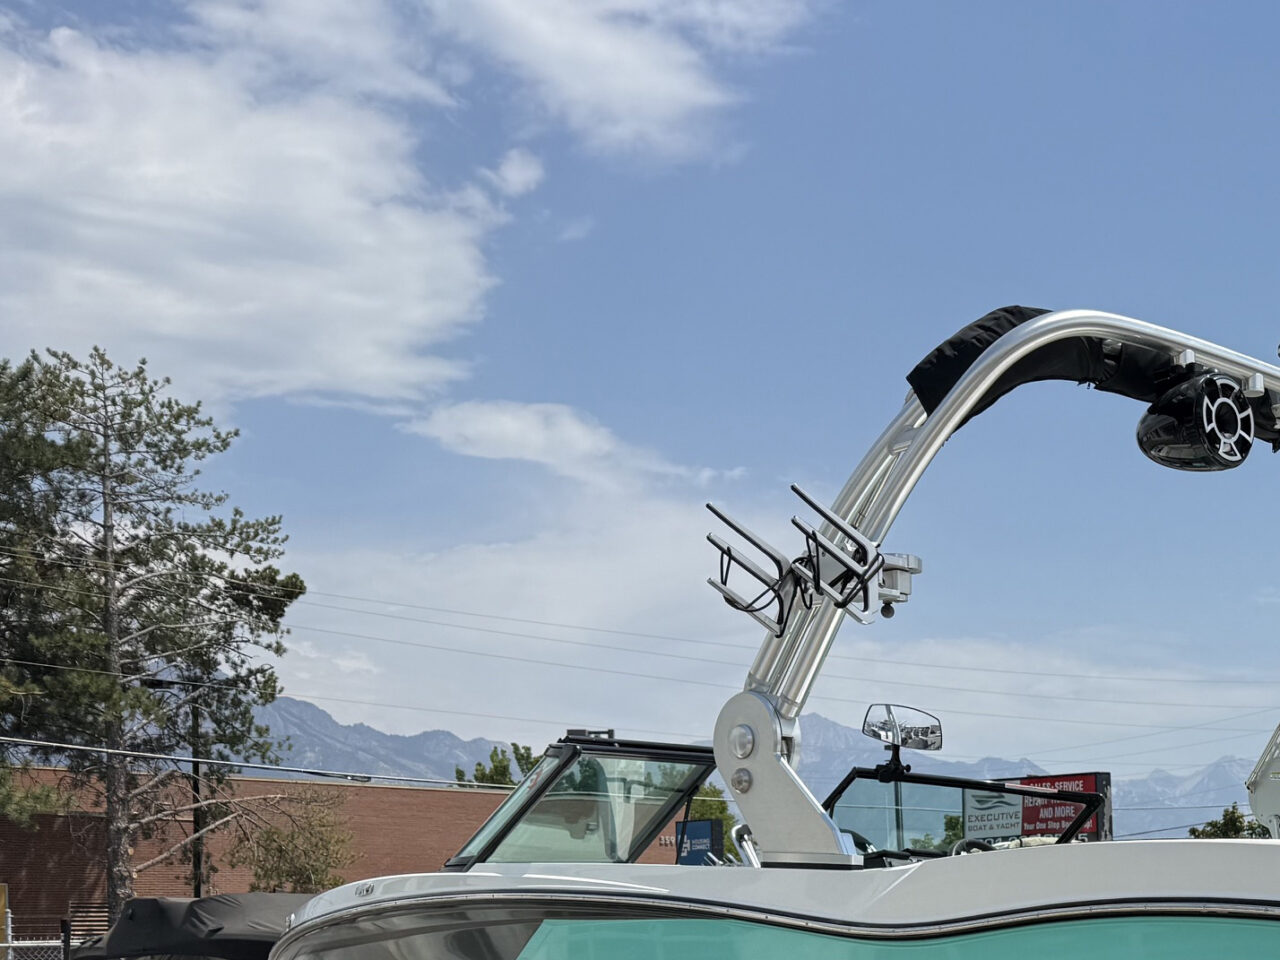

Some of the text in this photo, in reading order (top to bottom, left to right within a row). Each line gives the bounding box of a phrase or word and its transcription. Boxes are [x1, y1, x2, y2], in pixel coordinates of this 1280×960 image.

[1054, 780, 1084, 792] SERVICE
[967, 811, 1021, 823] EXECUTIVE
[1039, 806, 1076, 819] AND MORE
[967, 824, 987, 832] BOAT
[995, 822, 1021, 831] YACHT
